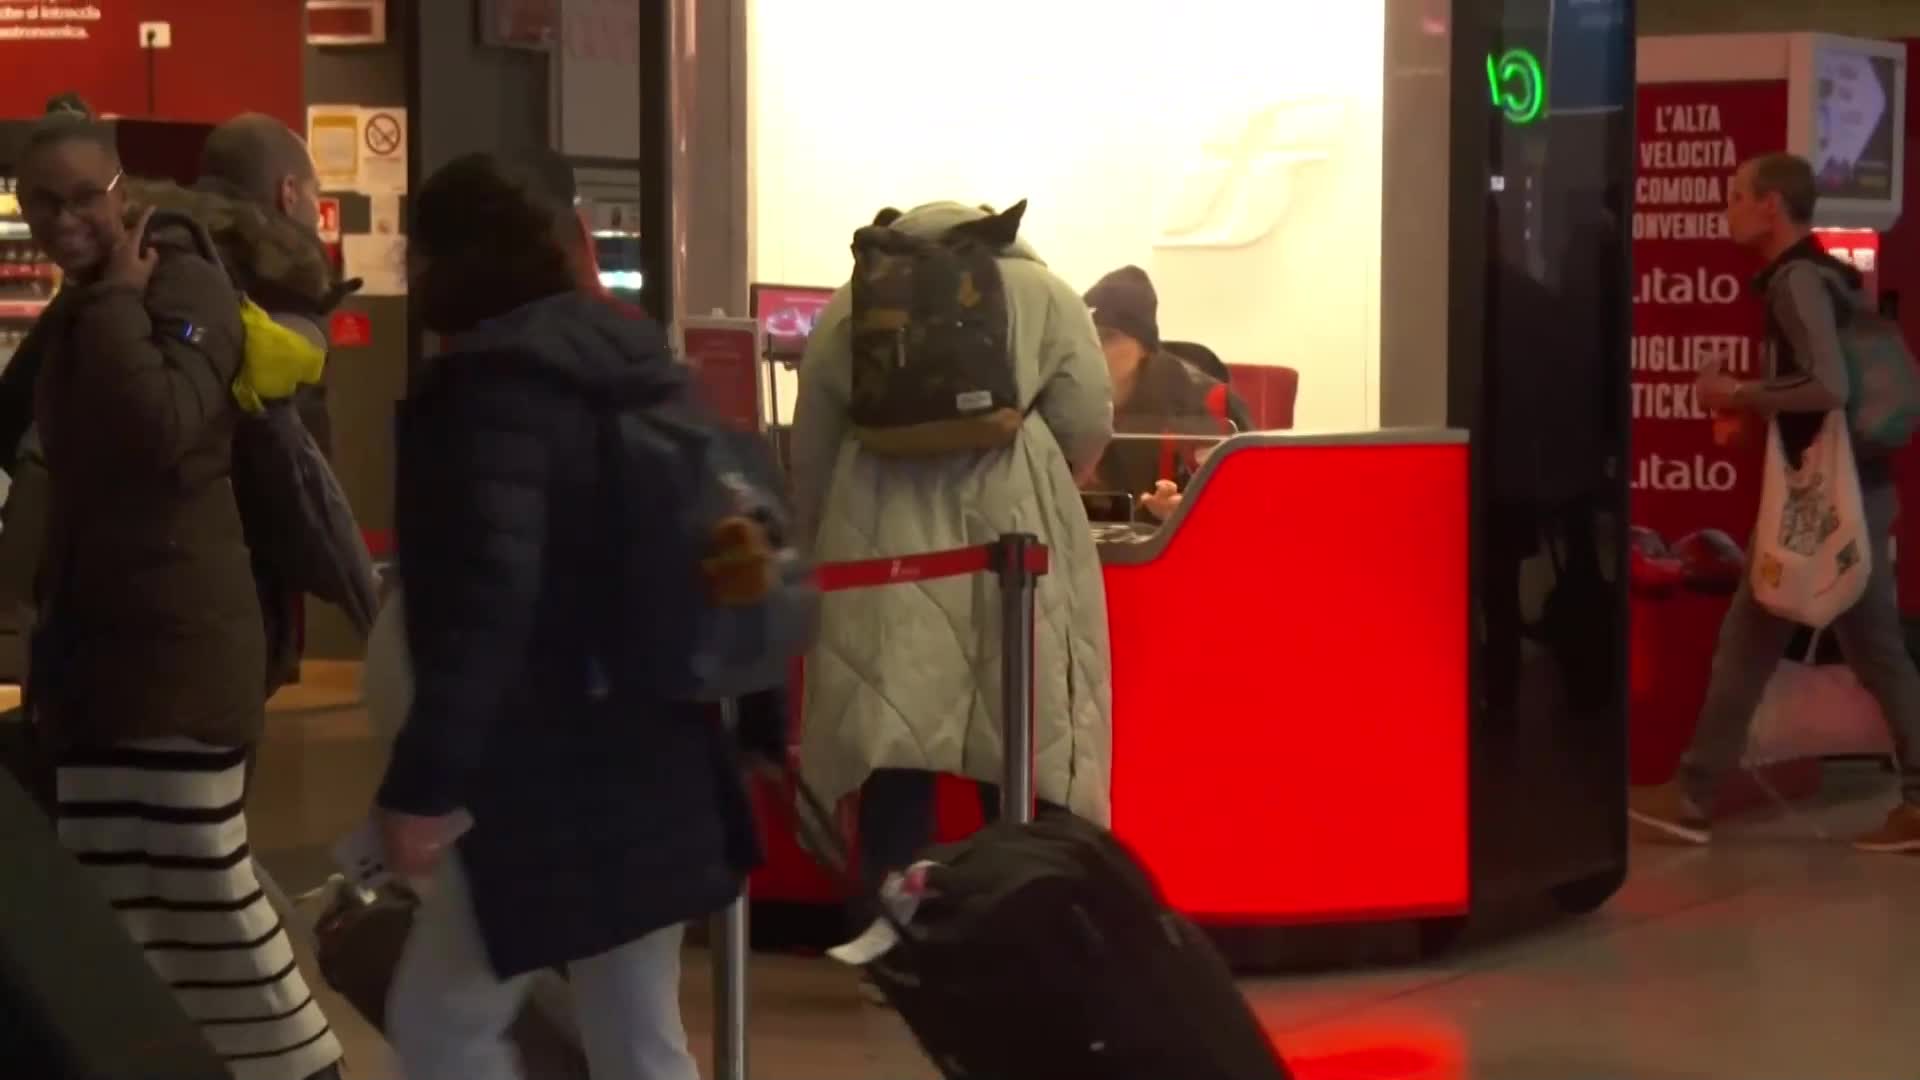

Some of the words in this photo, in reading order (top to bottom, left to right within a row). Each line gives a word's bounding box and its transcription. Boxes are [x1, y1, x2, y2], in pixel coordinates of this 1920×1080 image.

[1656, 104, 1721, 132] L'ALTA
[1640, 136, 1737, 168] VELOCITÀ
[1636, 176, 1721, 203] COMODA
[1632, 211, 1730, 239] ONVENIEN
